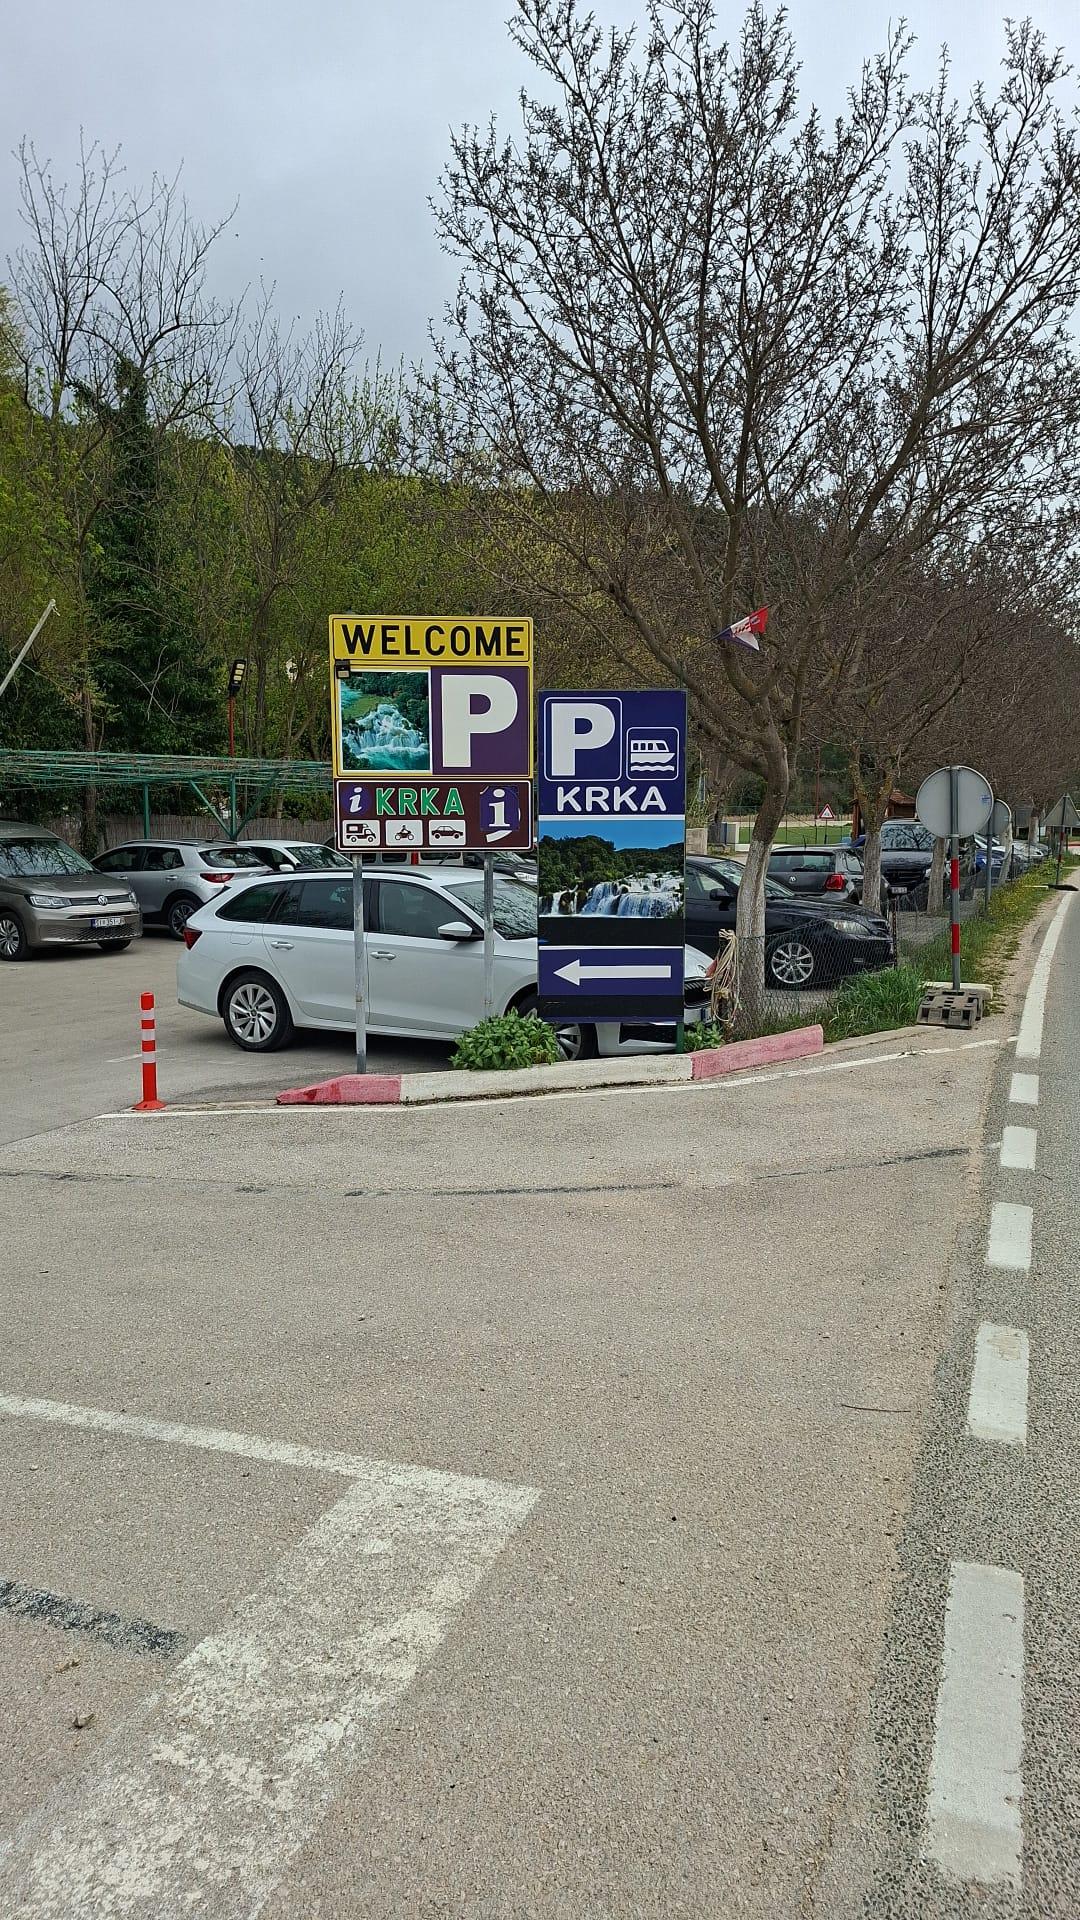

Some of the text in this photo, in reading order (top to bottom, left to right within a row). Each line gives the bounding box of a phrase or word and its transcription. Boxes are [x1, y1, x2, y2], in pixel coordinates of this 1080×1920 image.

[341, 624, 525, 657] WELCOME
[441, 674, 518, 768] P
[551, 703, 616, 776] P
[375, 787, 465, 816] KRKA
[557, 786, 667, 812] KRKA
